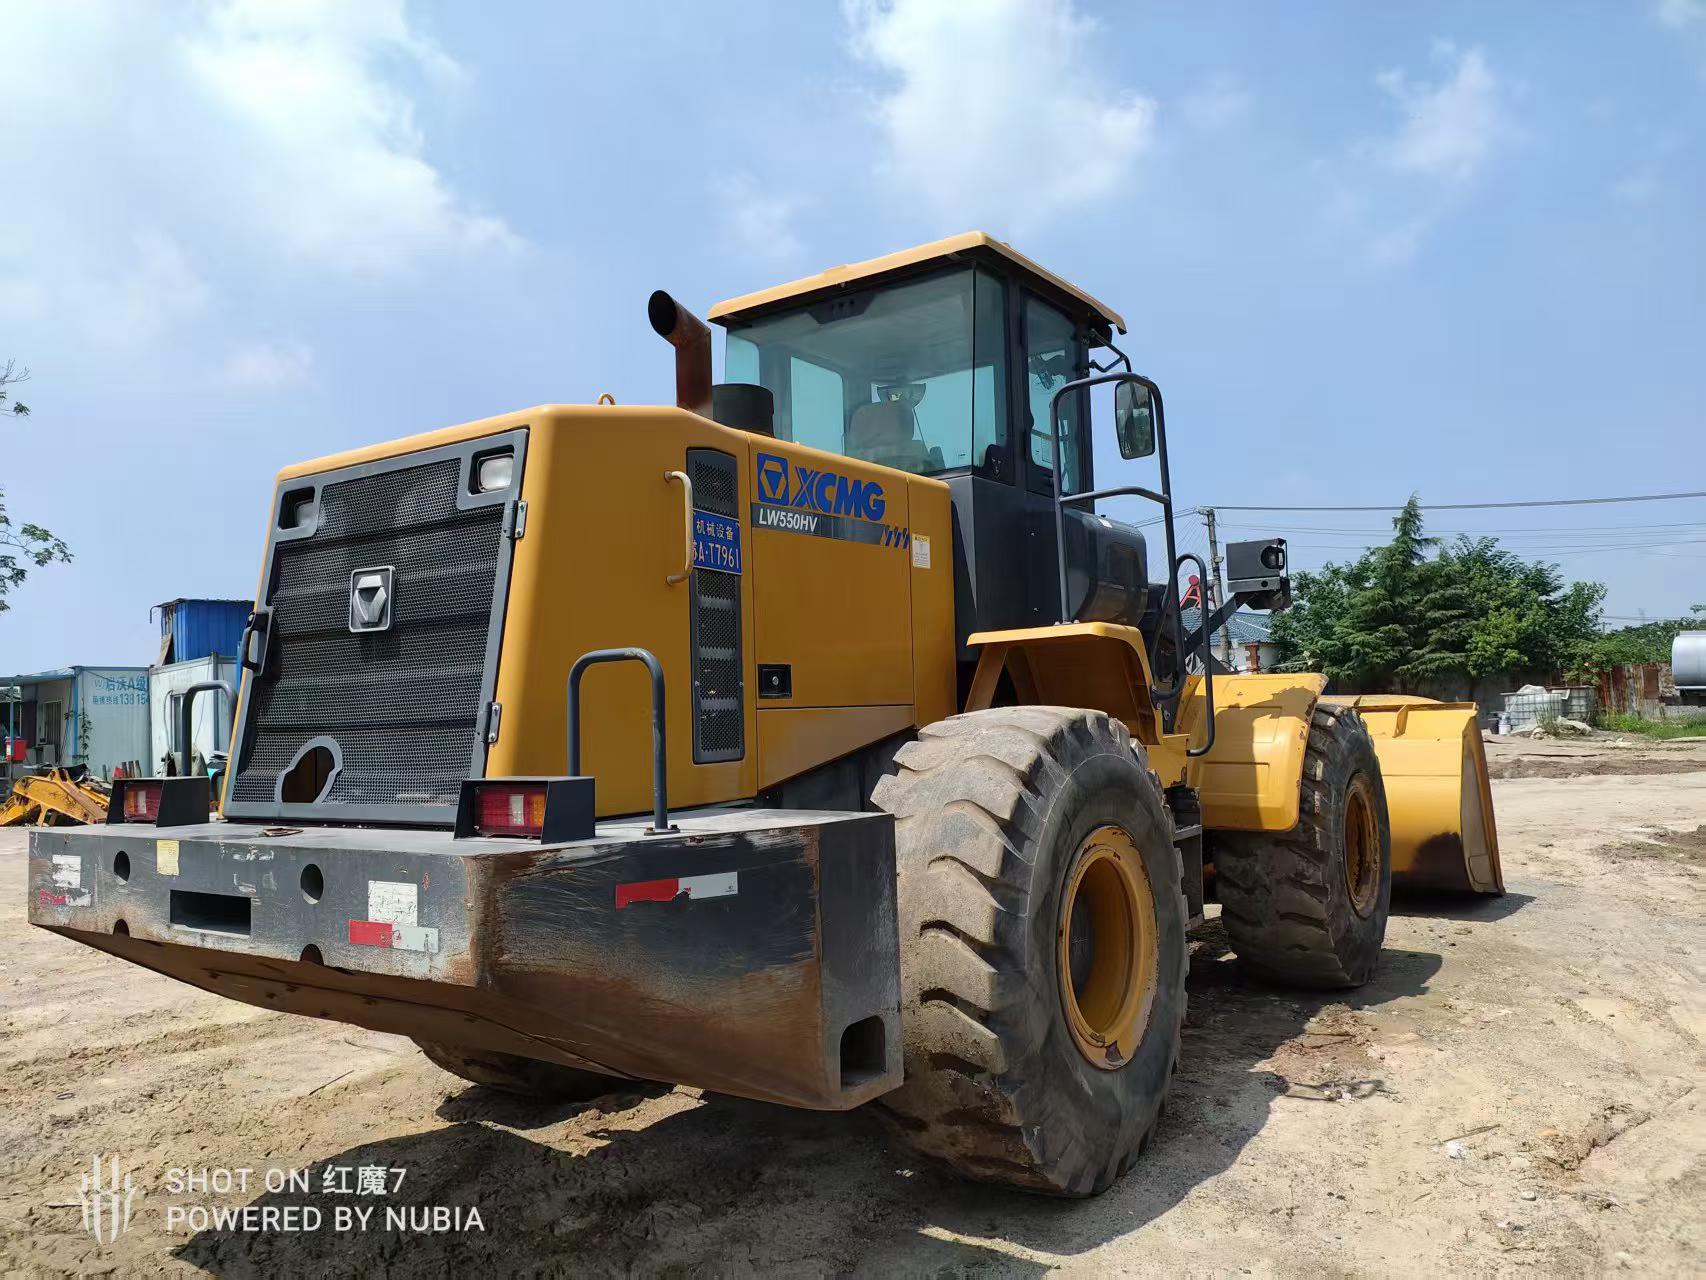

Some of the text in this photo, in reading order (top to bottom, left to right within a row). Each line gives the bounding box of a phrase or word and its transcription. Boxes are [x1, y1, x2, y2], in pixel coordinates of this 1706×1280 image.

[790, 465, 885, 521] XCMG
[696, 518, 734, 540] 机械设备
[758, 508, 817, 532] LW550HV
